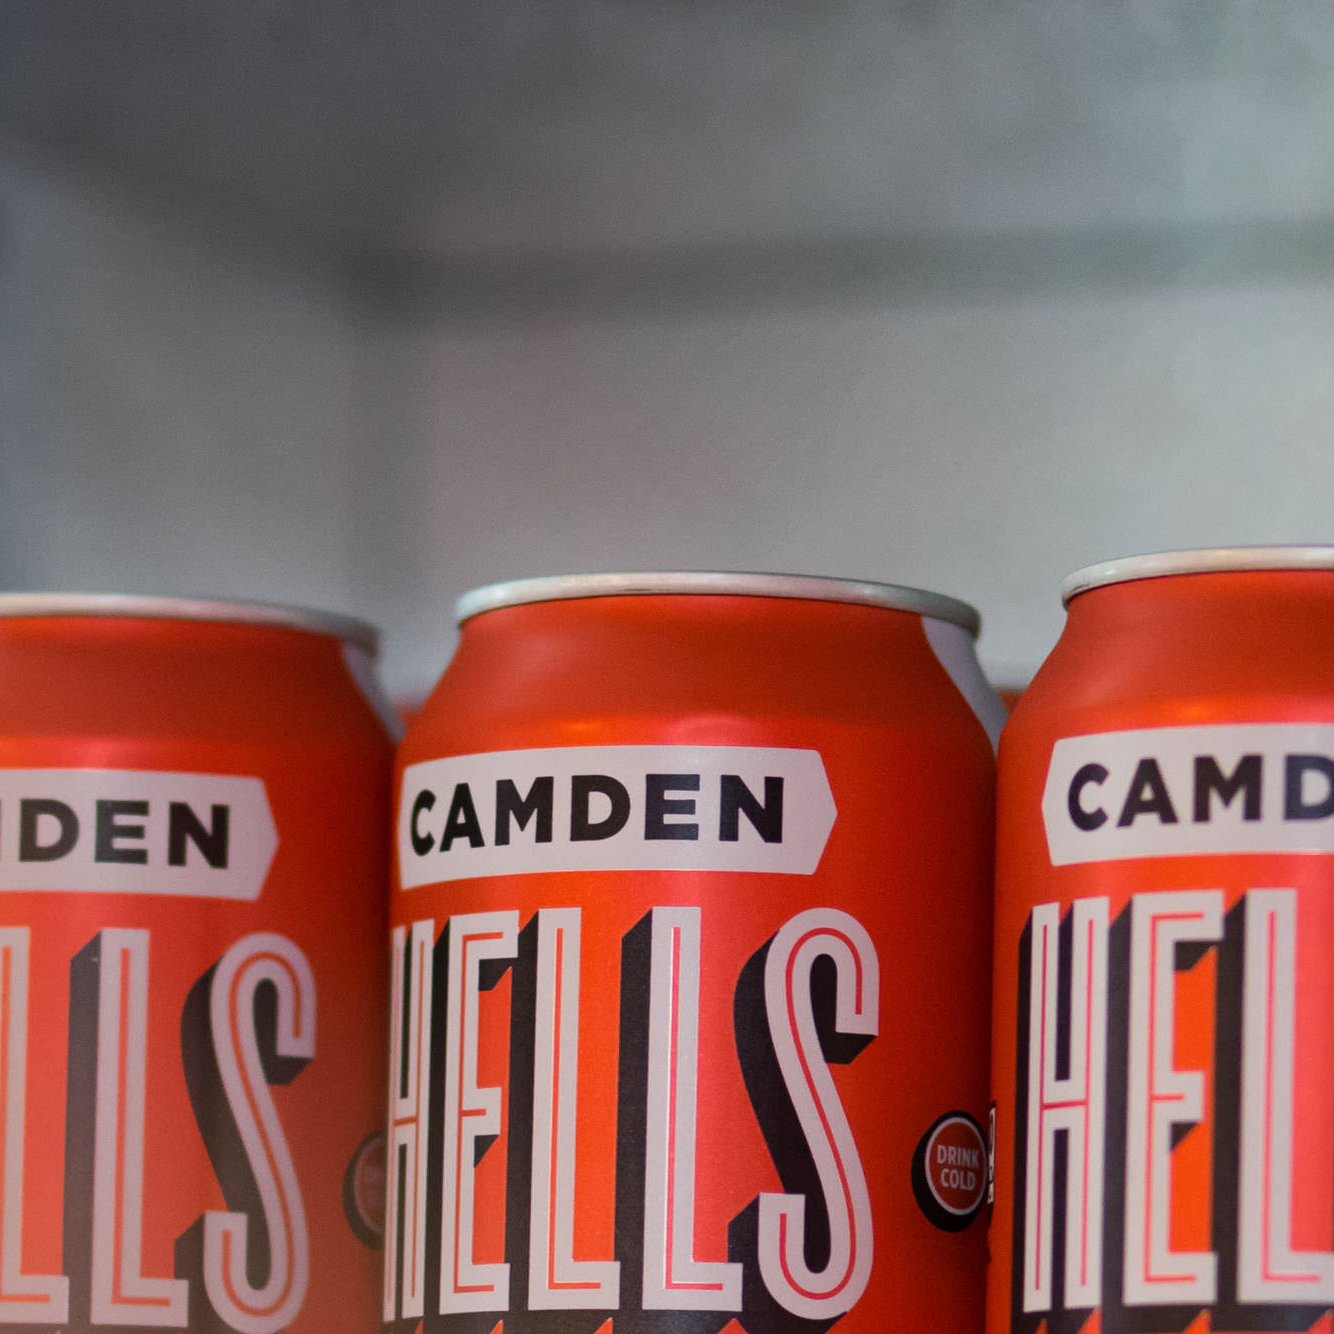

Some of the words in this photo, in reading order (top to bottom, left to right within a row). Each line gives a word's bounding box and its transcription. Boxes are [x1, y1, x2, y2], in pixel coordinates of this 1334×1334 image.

[409, 772, 785, 857] CAMDEN
[936, 1143, 980, 1169] DRINK
[940, 1167, 976, 1191] COLD
